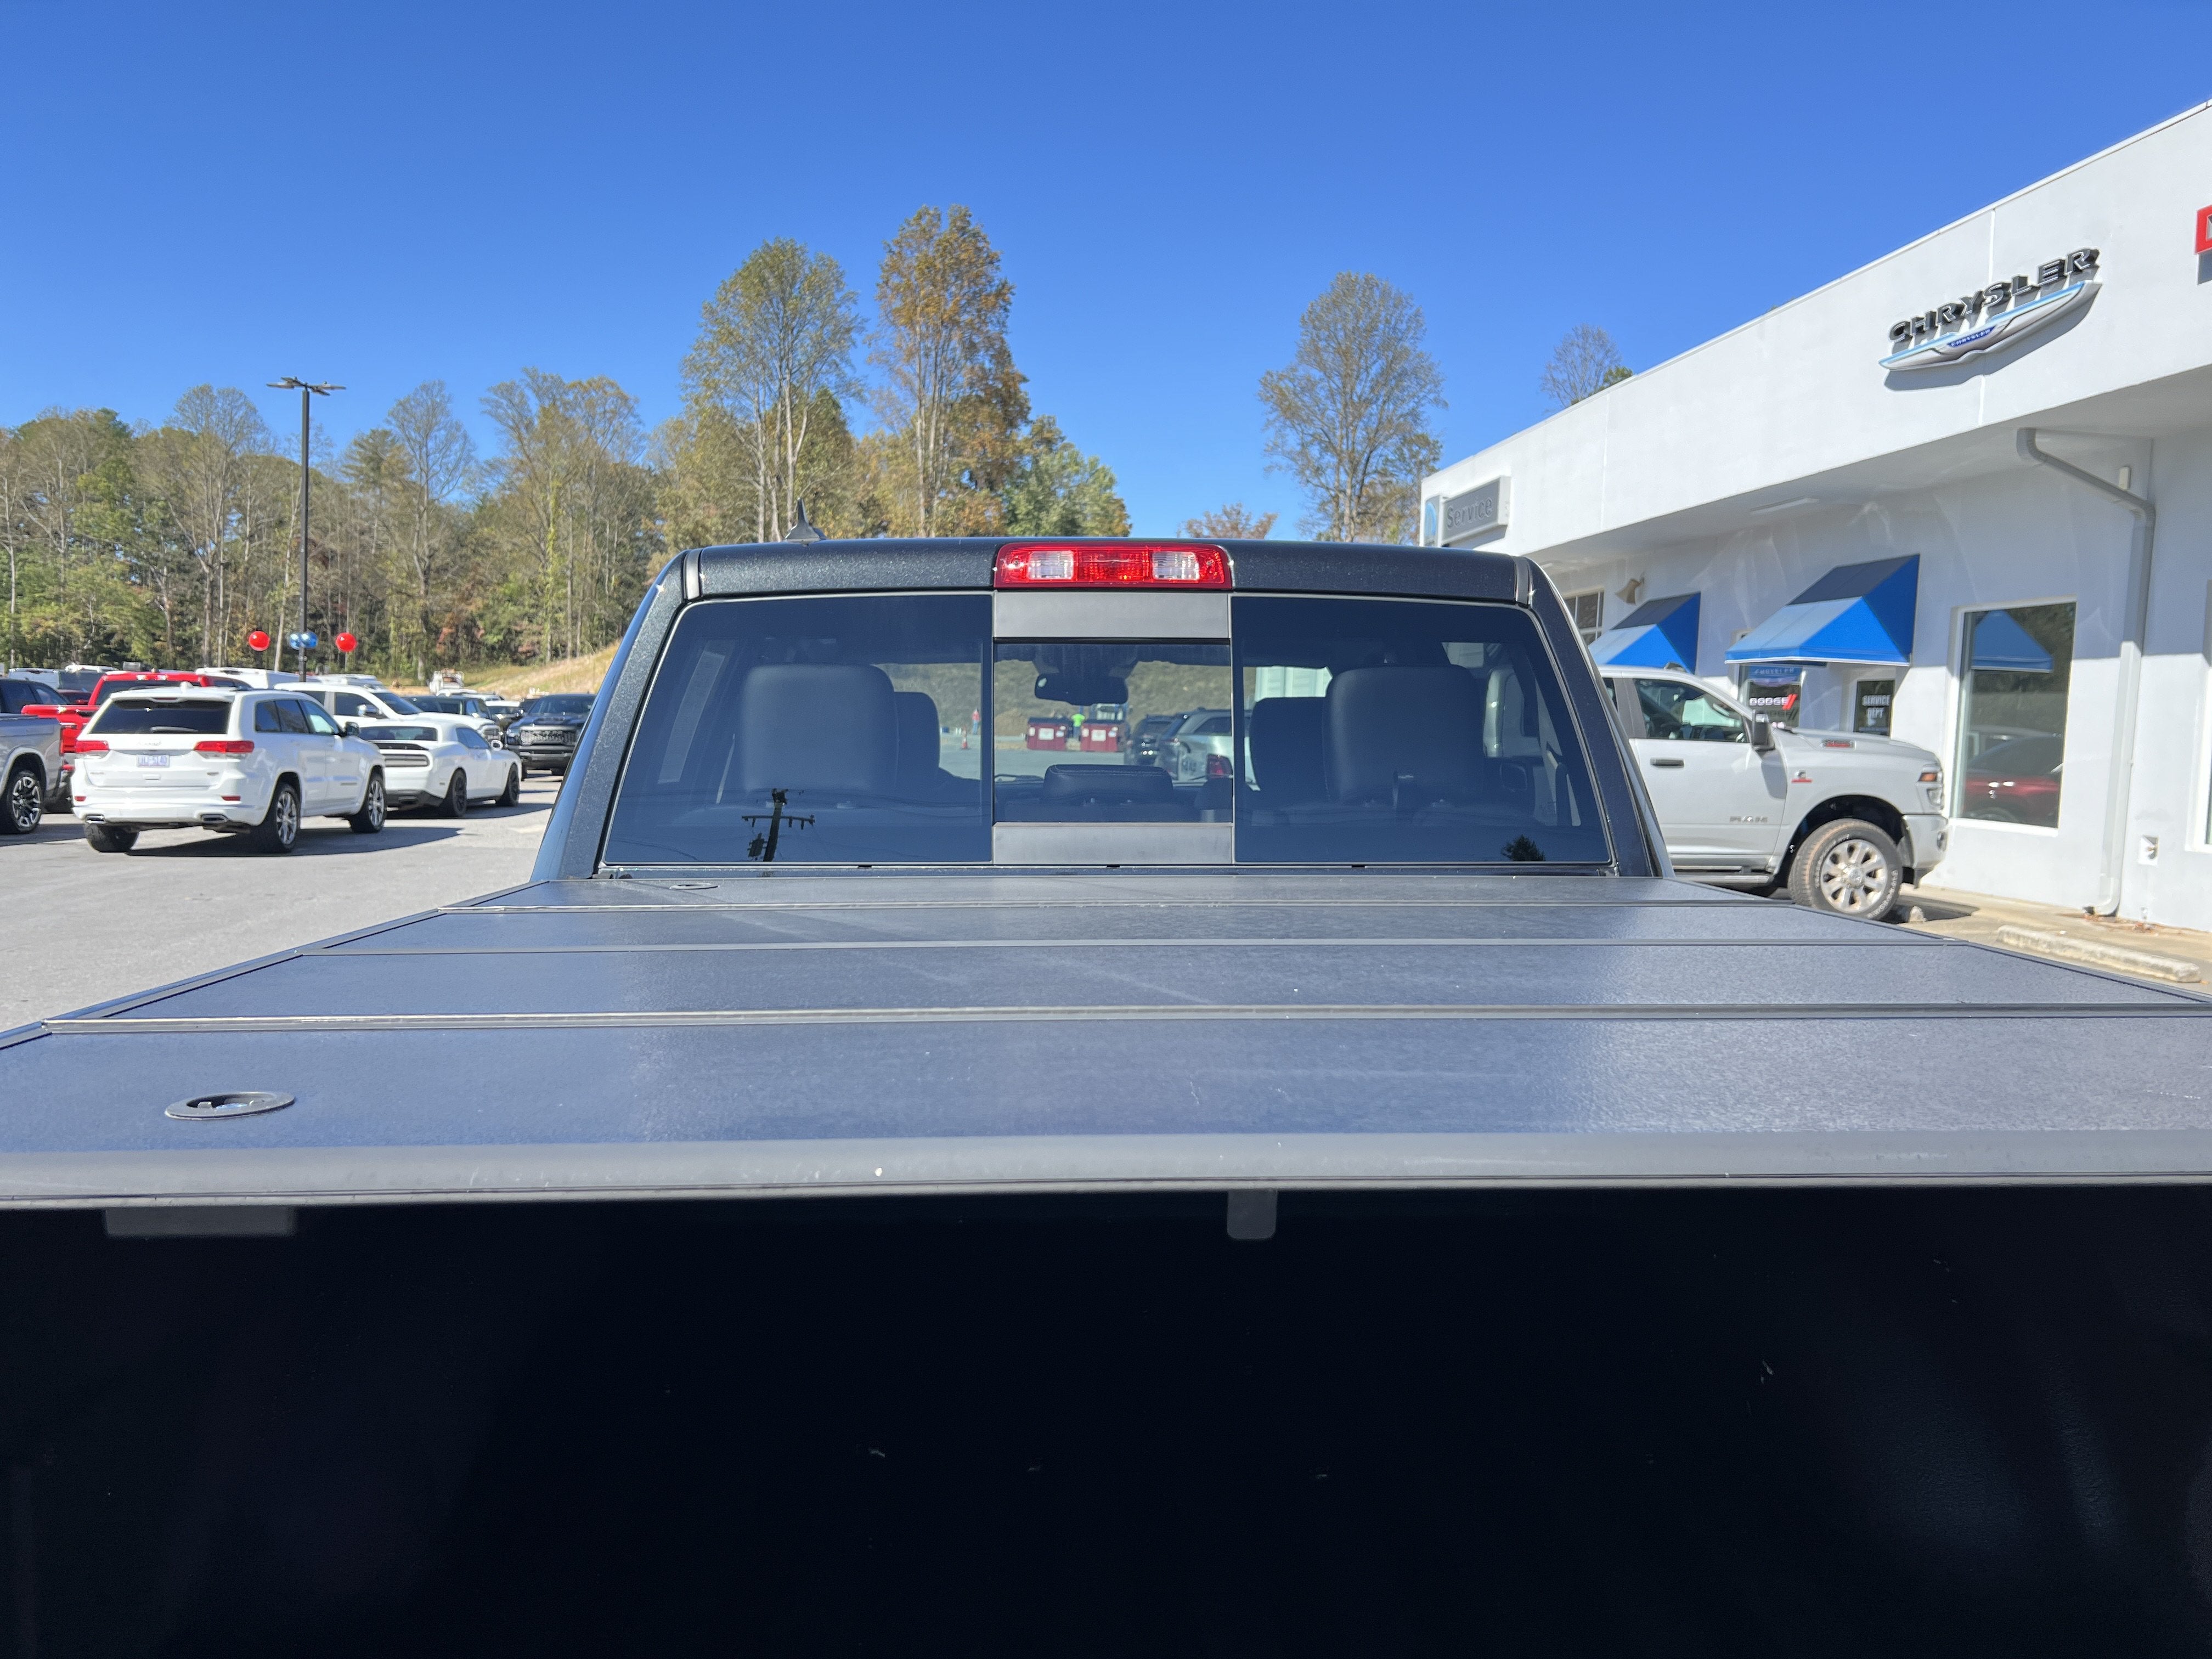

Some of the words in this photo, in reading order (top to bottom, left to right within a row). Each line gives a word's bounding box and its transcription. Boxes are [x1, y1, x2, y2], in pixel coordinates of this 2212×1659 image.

[1889, 248, 2100, 343] CHRYSLER
[1447, 498, 1492, 528] Service
[1750, 697, 1788, 706] DODGE
